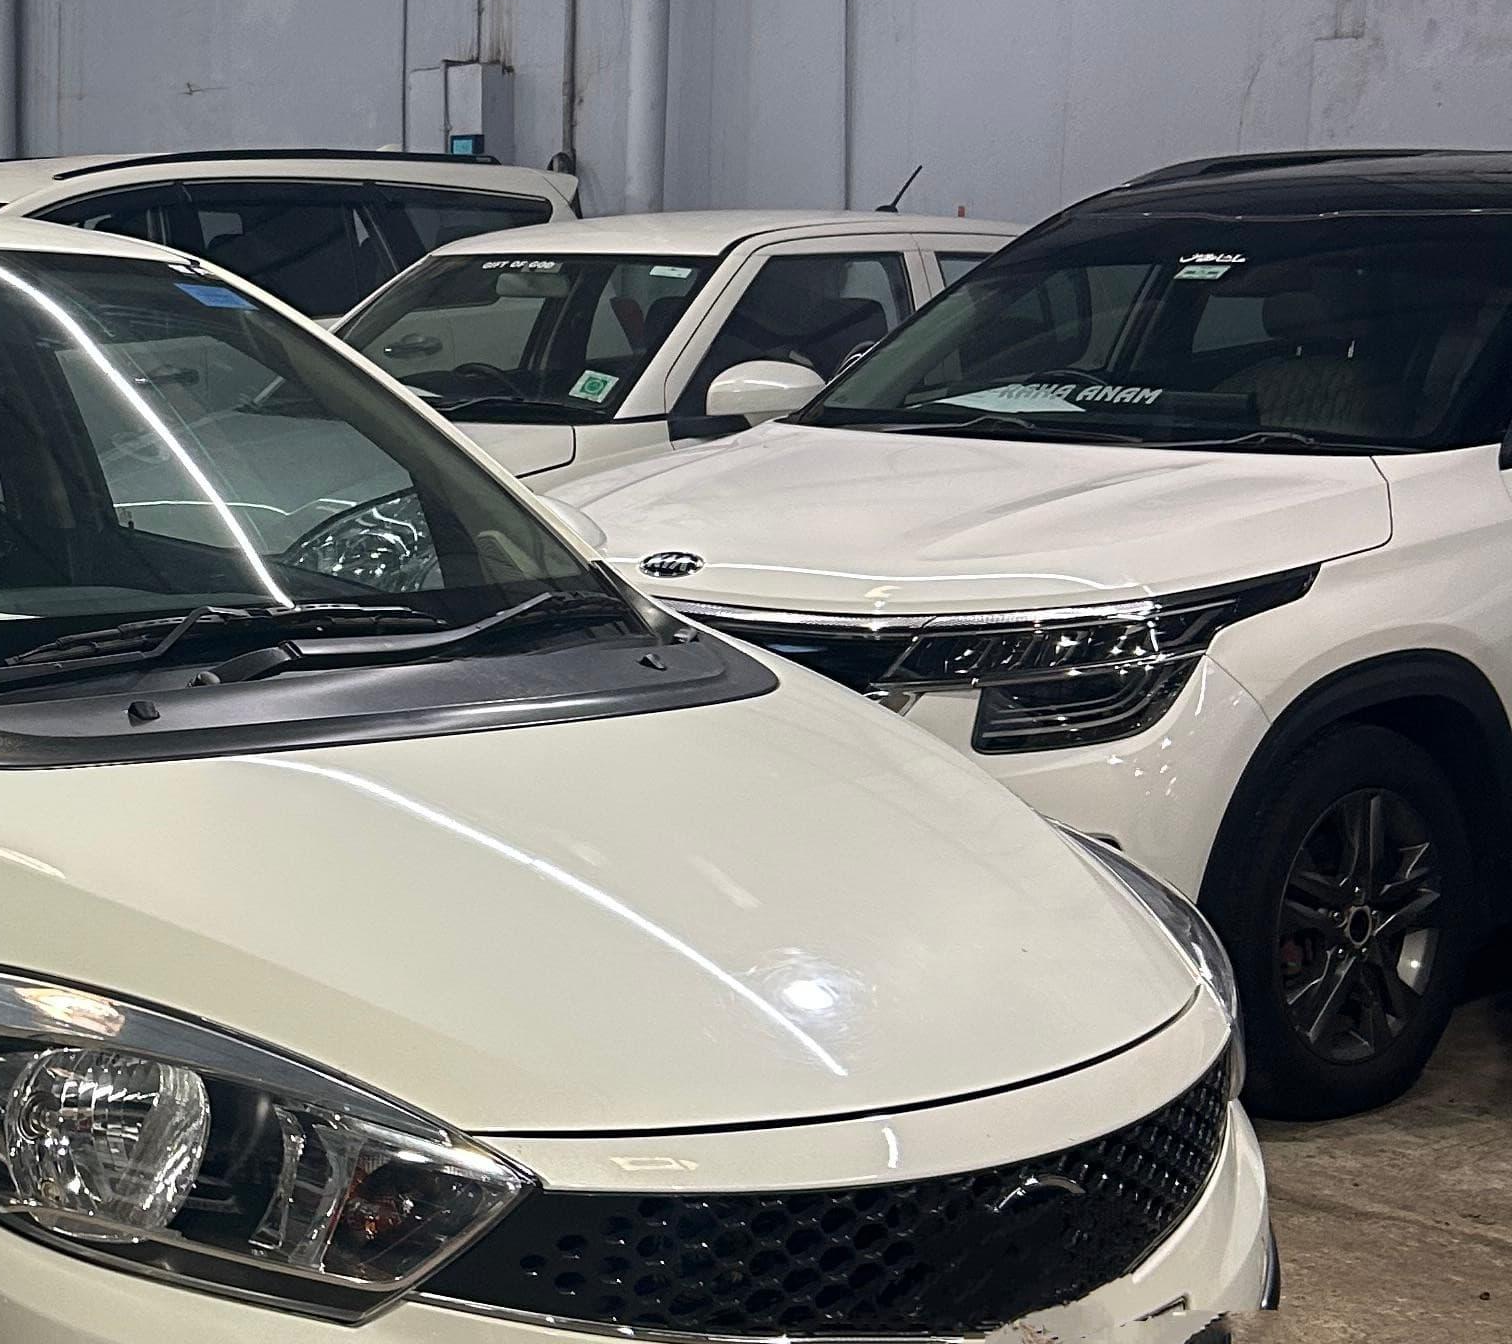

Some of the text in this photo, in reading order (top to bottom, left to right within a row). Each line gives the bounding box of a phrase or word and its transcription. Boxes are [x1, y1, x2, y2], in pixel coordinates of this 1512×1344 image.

[510, 260, 529, 268] OF
[529, 261, 555, 269] GOD
[1075, 385, 1163, 404] ANAM
